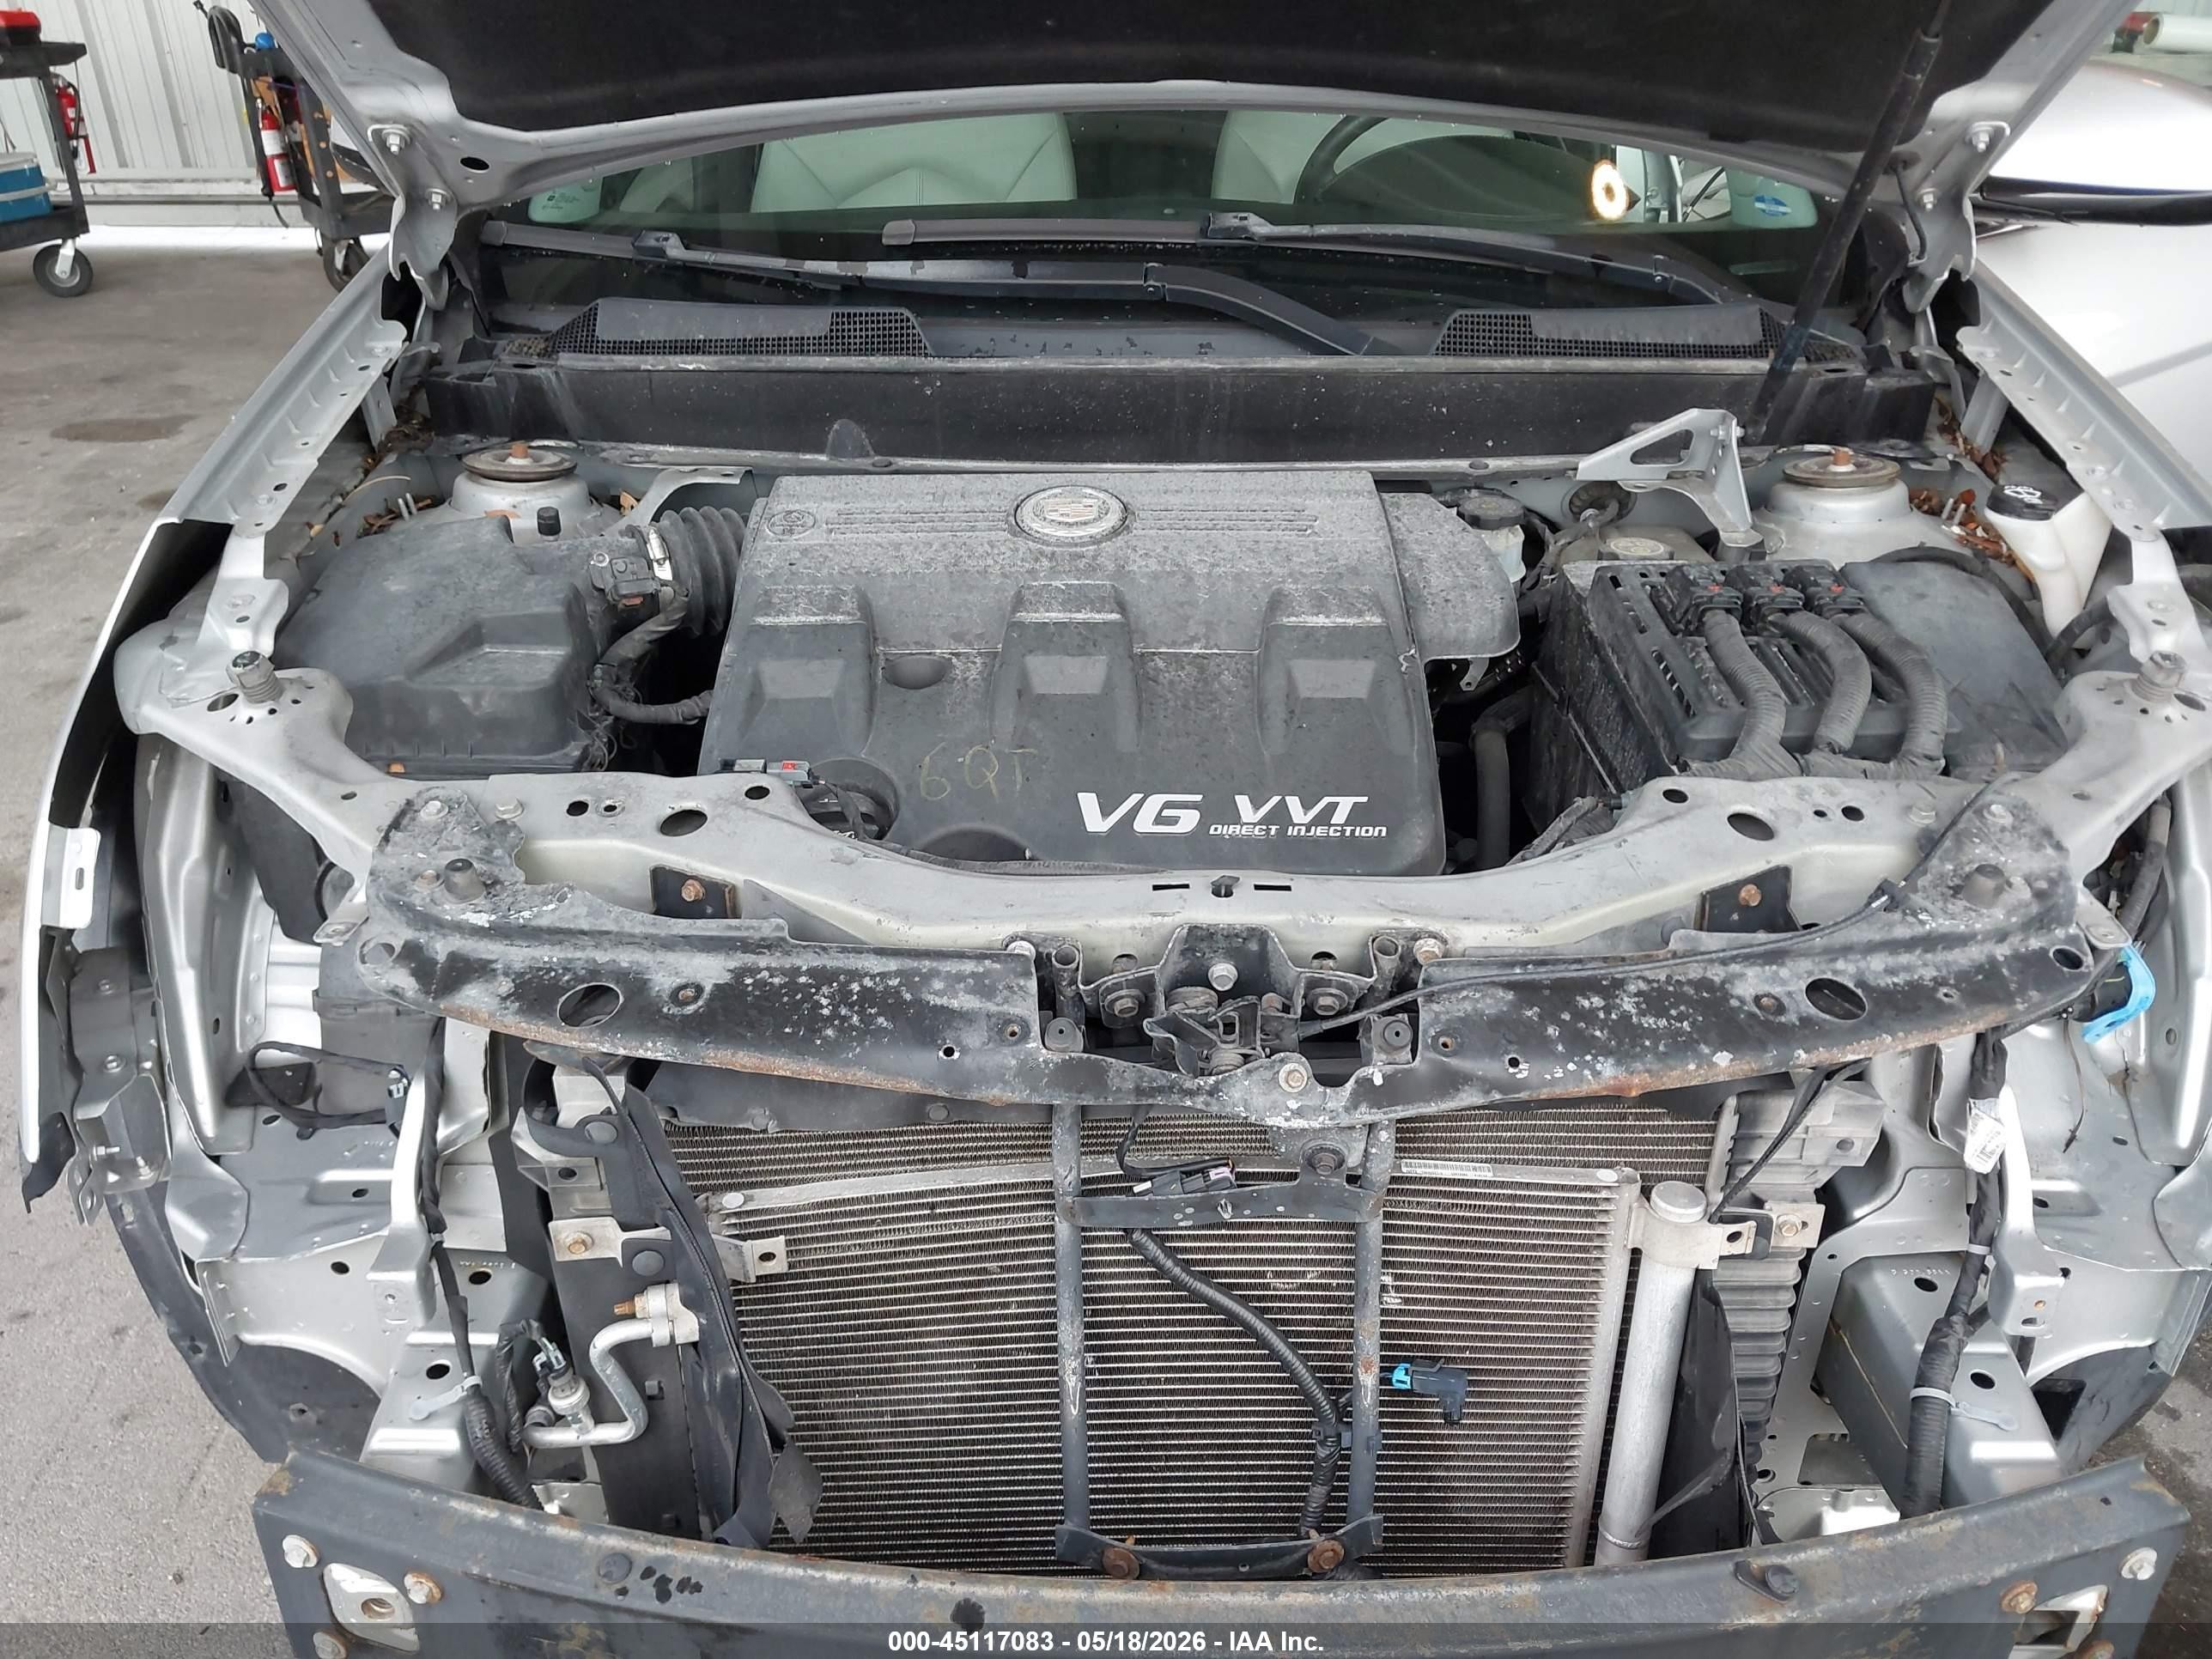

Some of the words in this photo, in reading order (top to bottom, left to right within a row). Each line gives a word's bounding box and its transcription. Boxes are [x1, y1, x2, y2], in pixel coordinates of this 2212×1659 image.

[1076, 792, 1204, 835] V6
[1234, 794, 1370, 824] VVT
[1208, 824, 1280, 837] DIRECT
[1286, 825, 1388, 838] INJECTION
